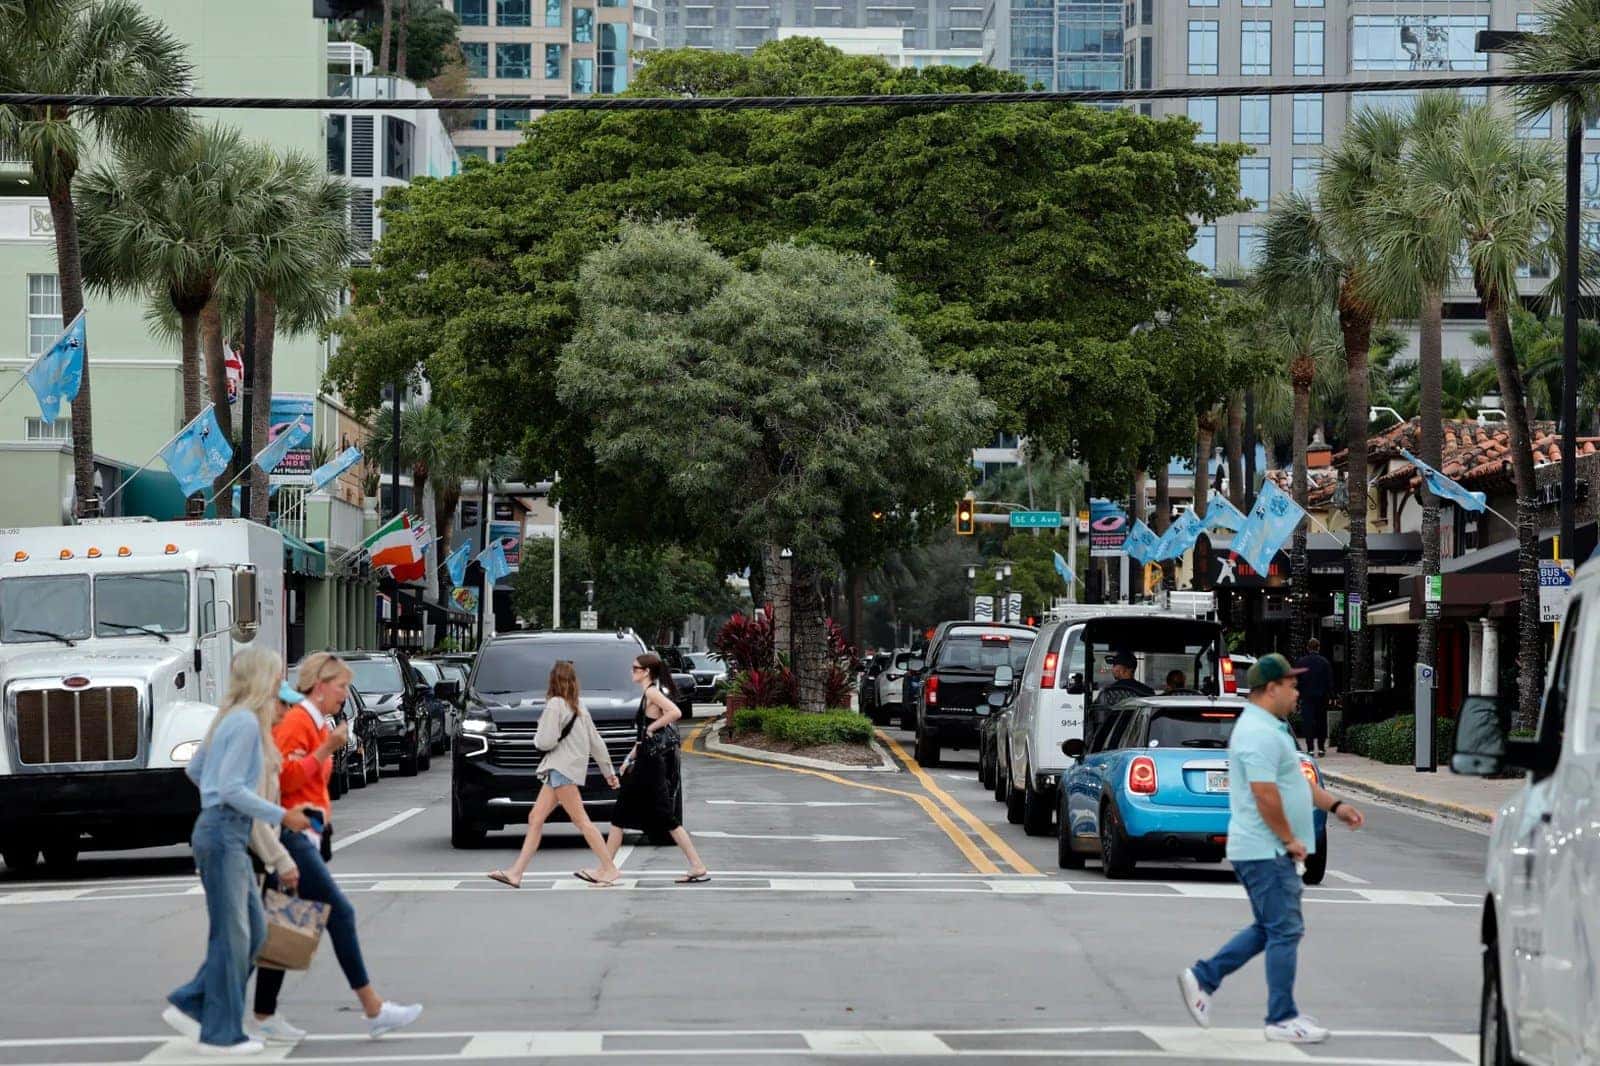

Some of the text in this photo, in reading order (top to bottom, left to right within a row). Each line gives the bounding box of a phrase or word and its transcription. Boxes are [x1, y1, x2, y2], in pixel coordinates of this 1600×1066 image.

[1030, 515, 1037, 523] 6
[1040, 515, 1057, 523] Ave
[1540, 568, 1560, 577] BUS
[1540, 576, 1566, 585] STOP
[1543, 605, 1550, 613] 11
